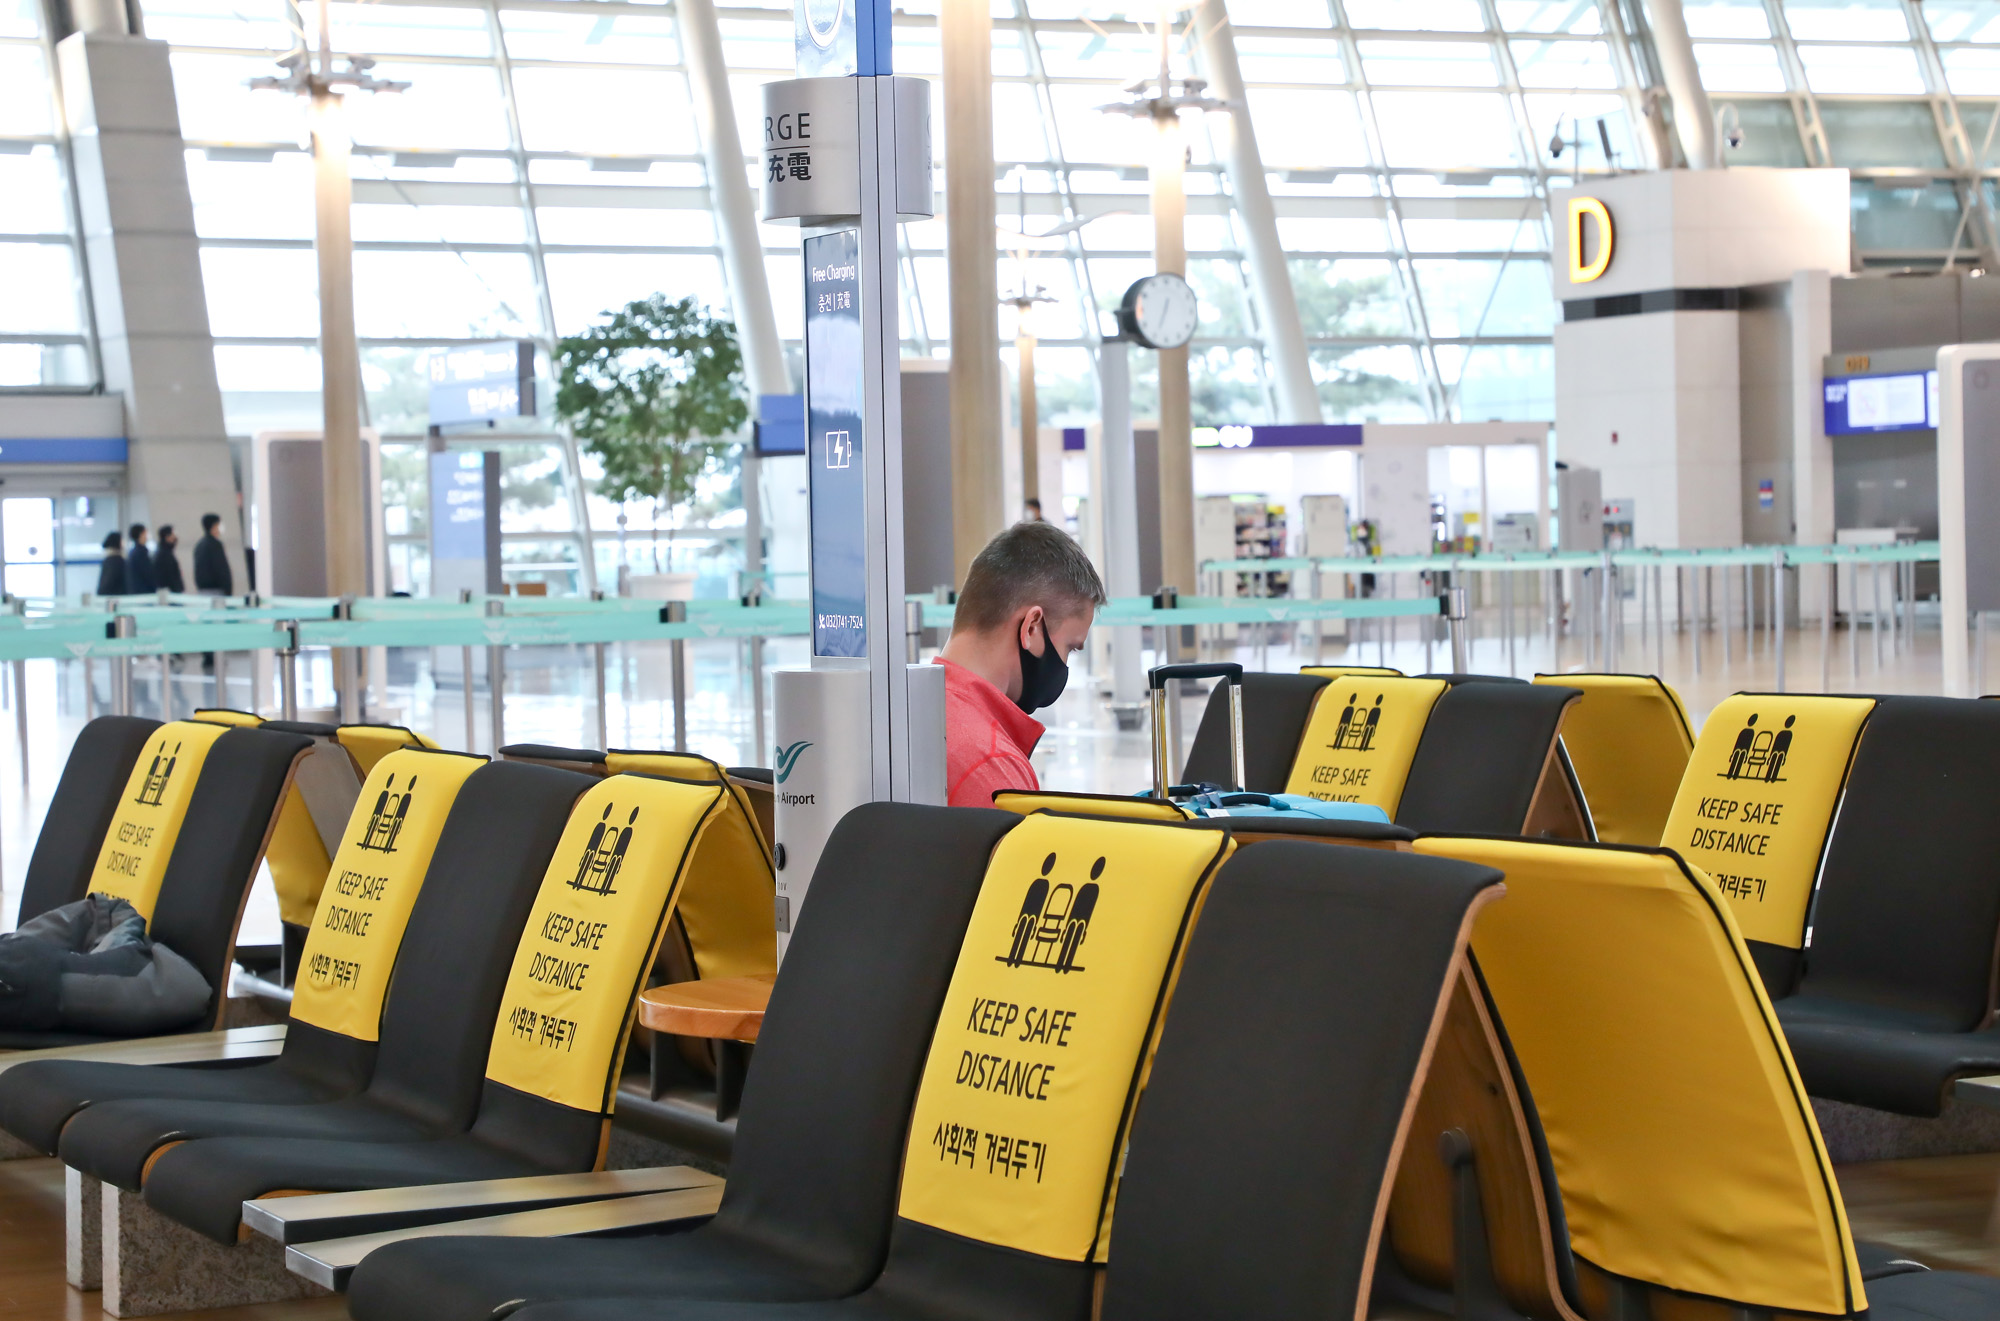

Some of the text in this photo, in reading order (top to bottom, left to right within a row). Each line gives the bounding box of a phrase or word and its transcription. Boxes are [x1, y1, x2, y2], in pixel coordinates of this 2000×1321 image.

[768, 152, 812, 183] 充電
[1568, 196, 1613, 284] D
[812, 262, 855, 283] Free Charging
[1311, 765, 1371, 787] KEEP SAFE
[781, 791, 815, 807] Airport
[1697, 797, 1783, 825] KEEP SAFE
[117, 822, 154, 847] KEEP SAFE
[1690, 827, 1770, 856] DISTANCE
[107, 850, 141, 877] DISTANCE
[336, 870, 388, 901] KEEP SAFE
[1716, 873, 1767, 902] 거리두기
[325, 905, 372, 937] DISTANCE
[541, 911, 608, 951] KEEP SAFE
[309, 952, 361, 990] 사회적 거리두기
[528, 951, 590, 992] DISTANCE
[509, 1005, 578, 1053] 사회적 거리두기
[967, 997, 1077, 1047] KEEP SAFE
[956, 1050, 1056, 1101] DISTANCE
[933, 1121, 1047, 1184] 사회적 거리두기
